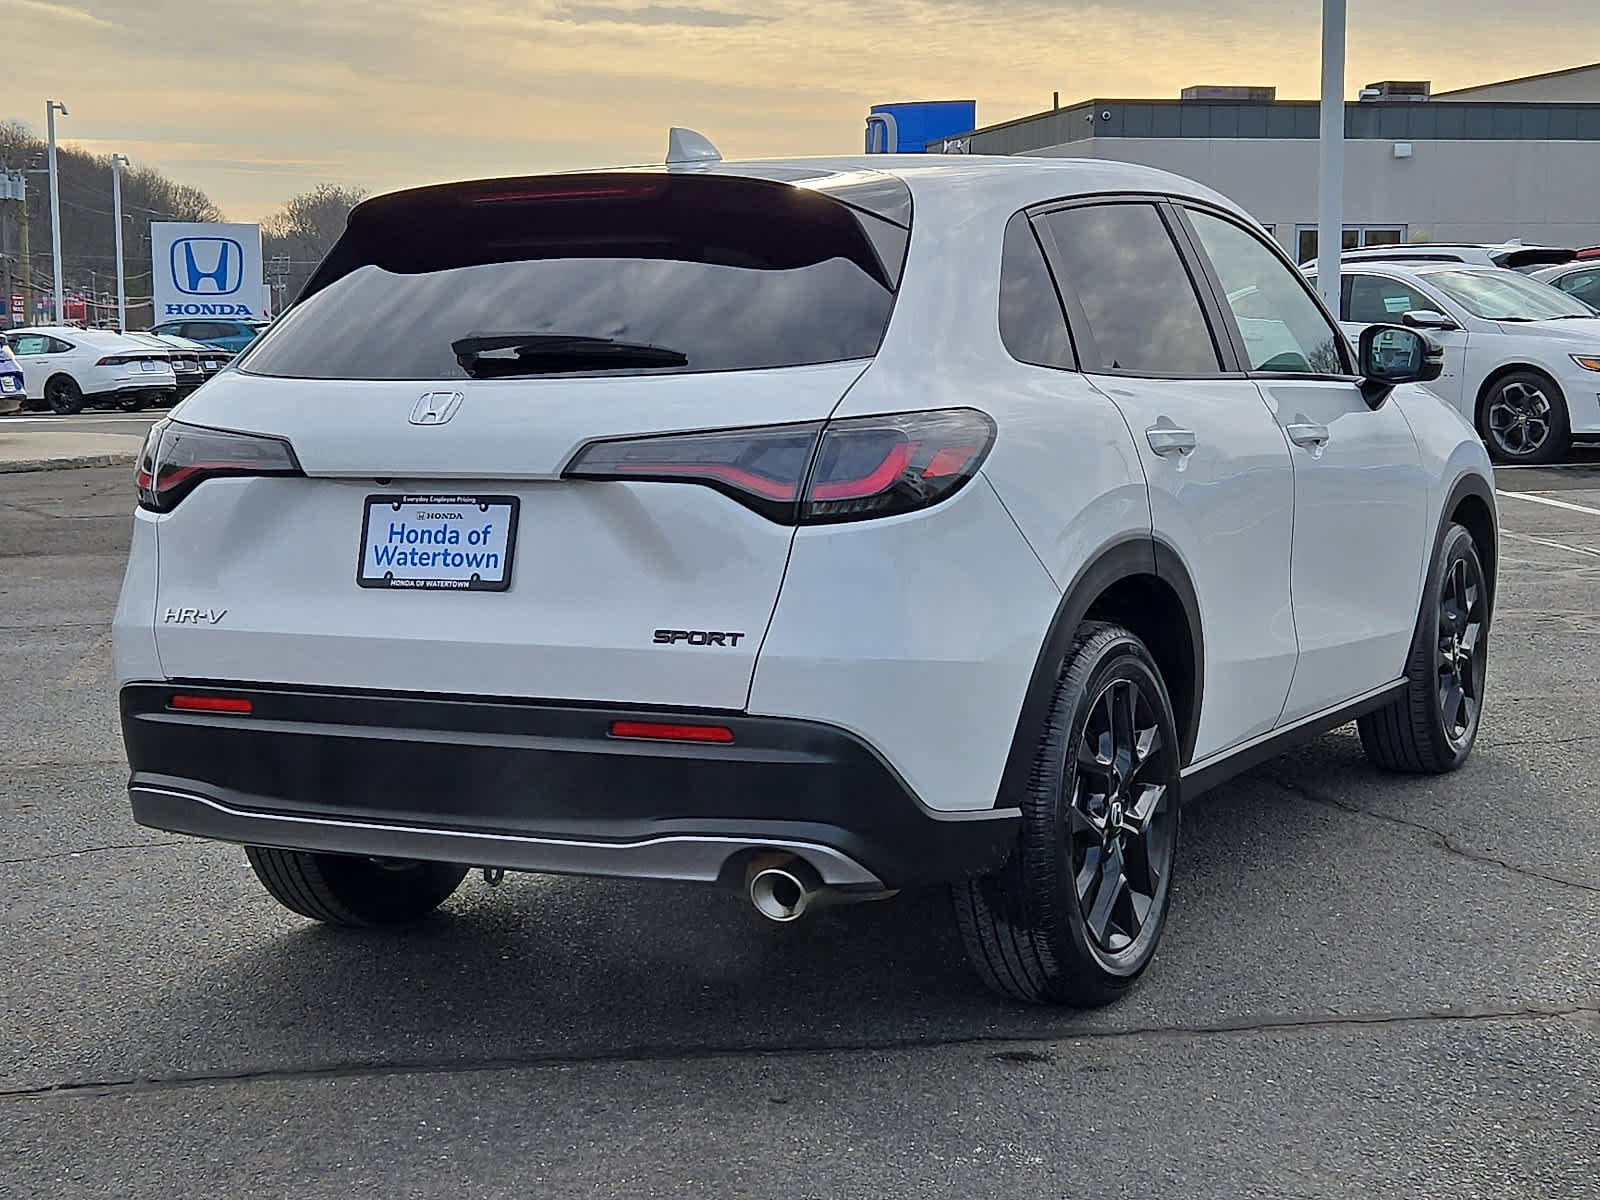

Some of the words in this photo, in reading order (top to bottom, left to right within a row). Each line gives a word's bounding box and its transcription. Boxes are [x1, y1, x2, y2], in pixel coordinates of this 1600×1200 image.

[165, 303, 252, 316] HONDA
[388, 523, 460, 545] Honda
[467, 525, 493, 545] of
[374, 545, 499, 568] Watertown
[164, 608, 228, 624] HR-V
[653, 629, 745, 647] SPORT
